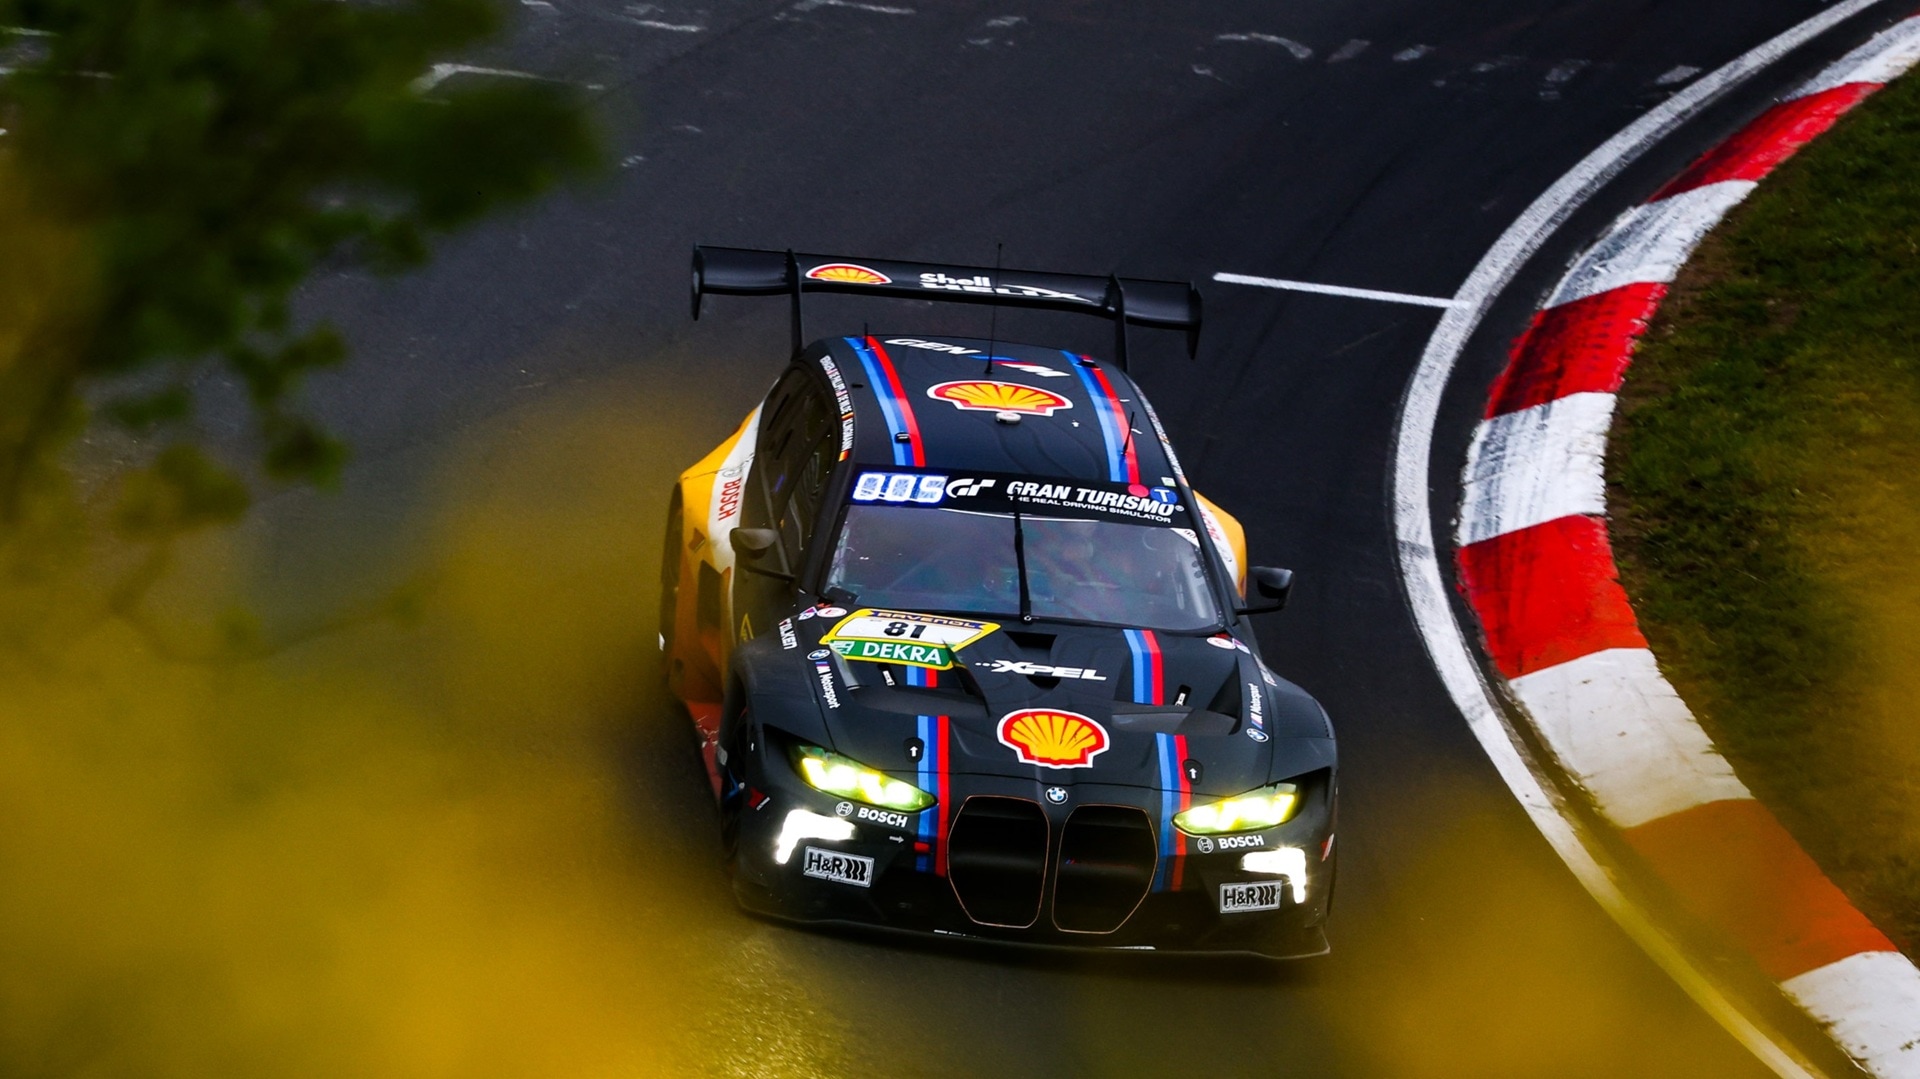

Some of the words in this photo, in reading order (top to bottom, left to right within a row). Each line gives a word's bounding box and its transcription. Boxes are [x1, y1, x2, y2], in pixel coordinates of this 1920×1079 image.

[919, 272, 991, 287] Shell
[884, 338, 982, 354] GEN
[718, 477, 742, 521] BOSCH
[1006, 480, 1071, 500] GRAN
[1032, 498, 1061, 506] REAL
[1062, 501, 1107, 512] DRIVING
[1108, 507, 1172, 523] SIMULATOR
[884, 621, 927, 639] 81
[862, 642, 942, 664] DEKRA
[990, 659, 1107, 680] XPEL
[819, 672, 841, 709] Motorsport
[1248, 682, 1262, 714] Motorsport
[857, 807, 908, 828] BOSCH
[1217, 835, 1265, 850] BOSCH
[807, 851, 844, 876] H&R
[1223, 886, 1257, 907] H&R
